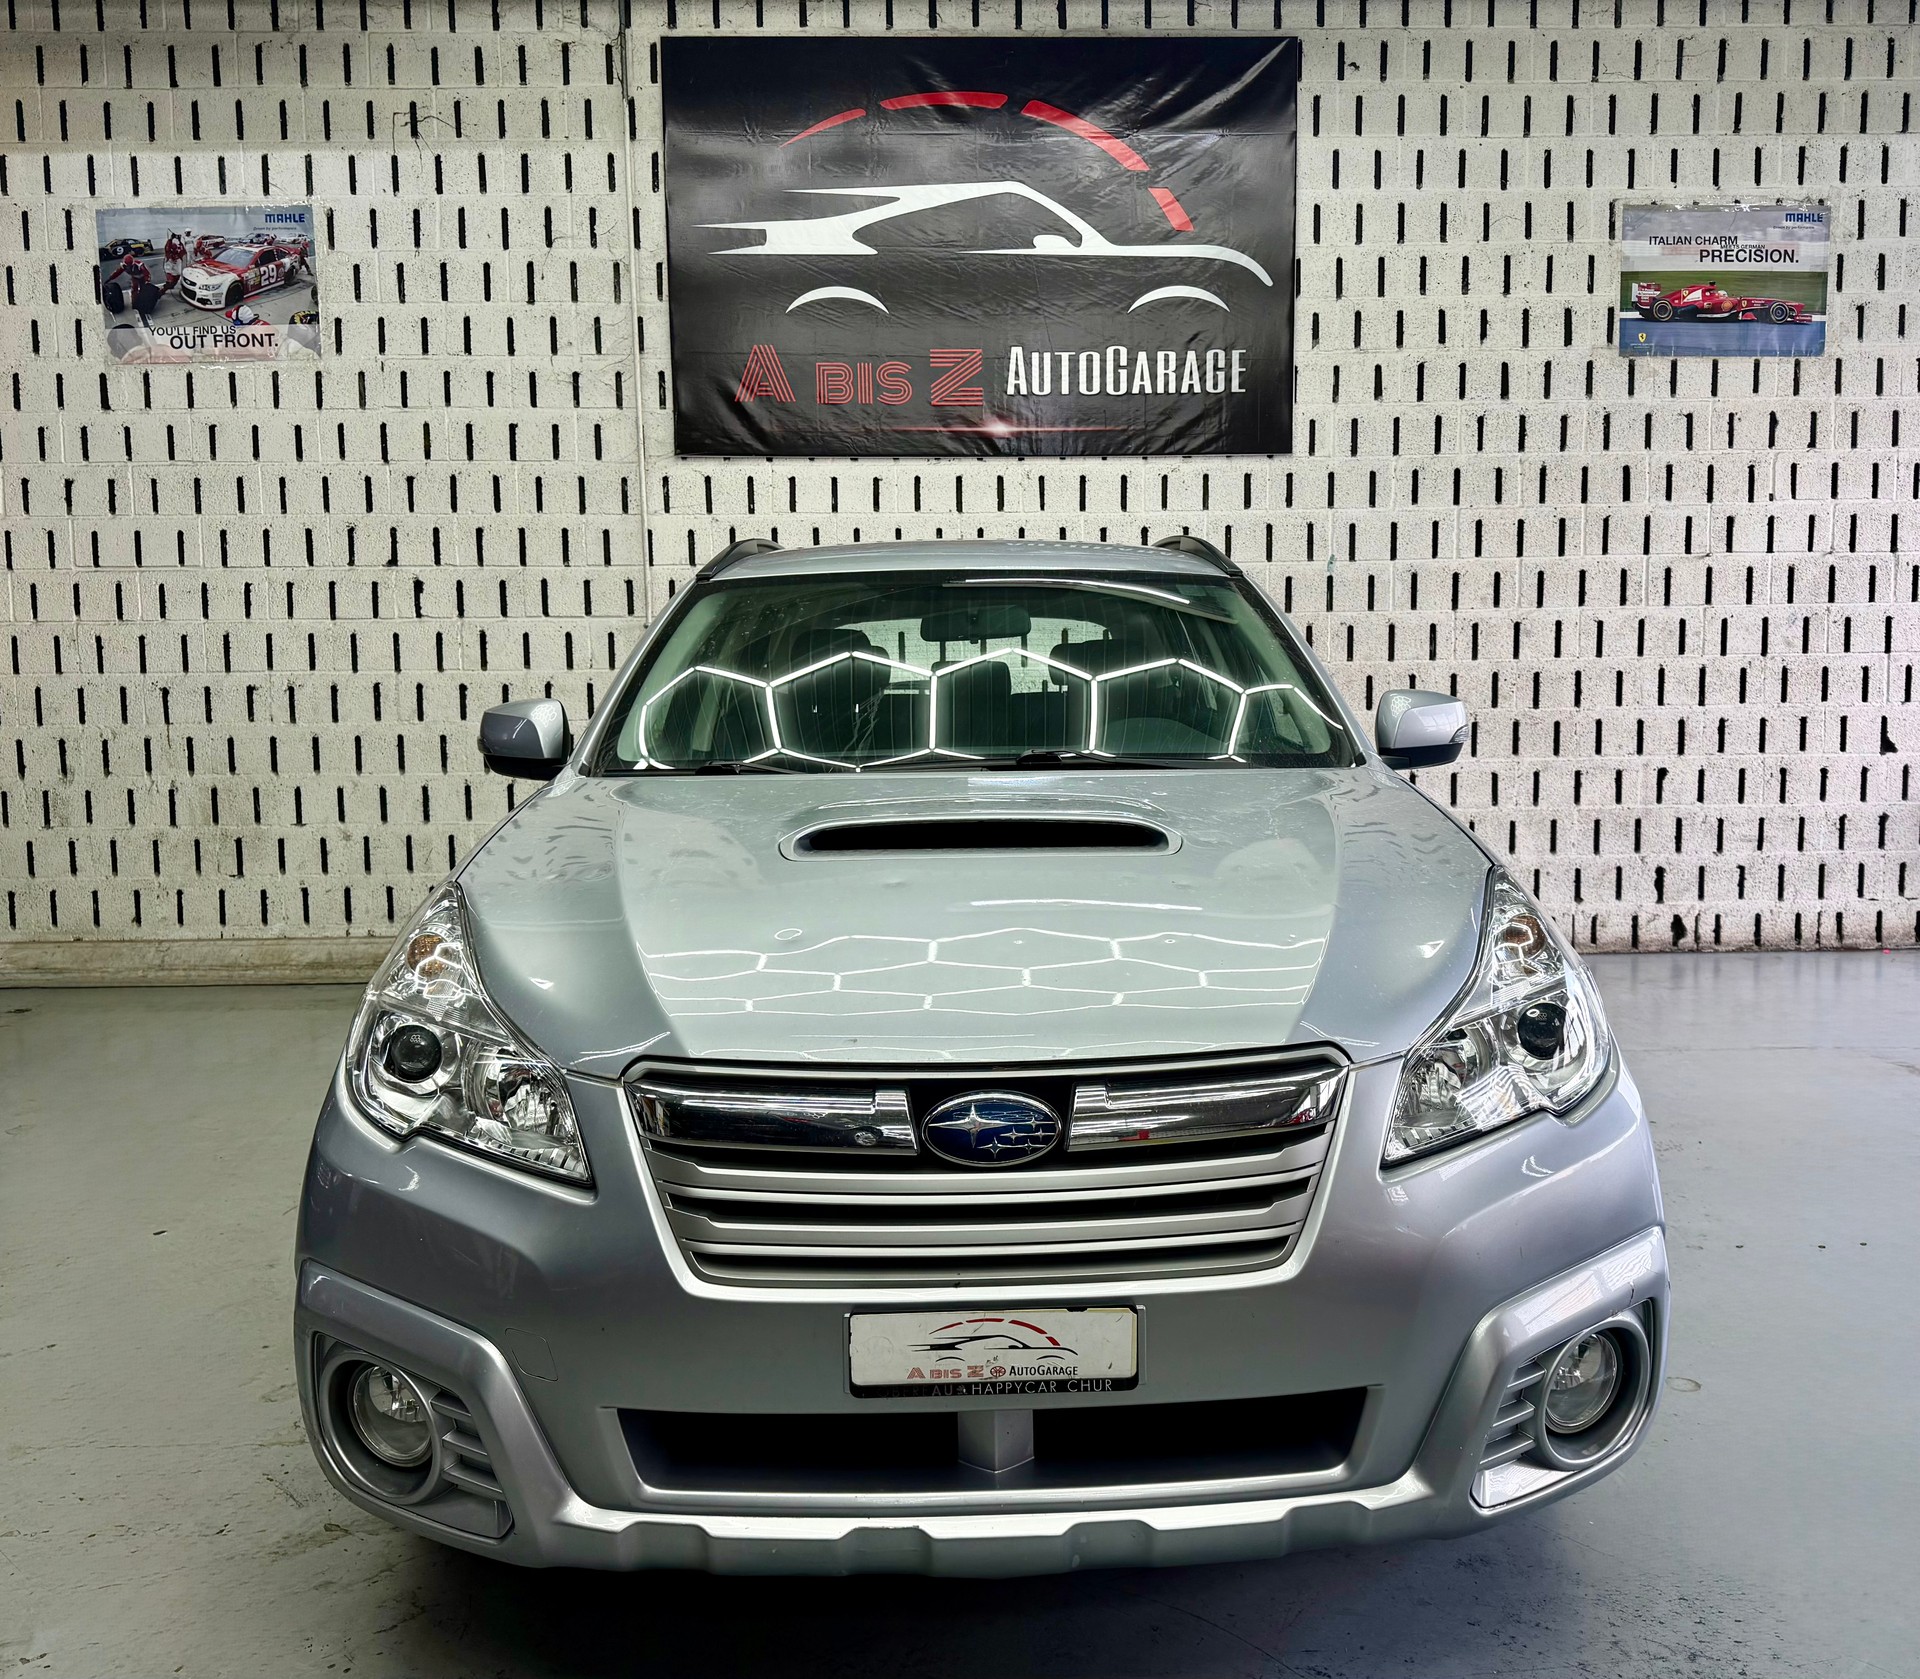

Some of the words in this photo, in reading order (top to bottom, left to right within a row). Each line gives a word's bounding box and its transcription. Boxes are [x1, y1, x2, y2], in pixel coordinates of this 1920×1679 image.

[265, 213, 306, 223] MAHLE
[1785, 213, 1824, 223] MAHLE
[1649, 236, 1692, 246] ITALIAN
[1695, 236, 1738, 246] CHARM
[1699, 249, 1799, 264] PRECISION.
[260, 264, 277, 287] 29
[149, 326, 191, 337] YOU'LL
[193, 326, 218, 335] FIND
[221, 325, 236, 335] US
[170, 334, 207, 350] OUT
[213, 333, 279, 348] FRONT.
[734, 343, 797, 403] A
[929, 348, 984, 407] Z
[906, 1367, 926, 1380] A
[967, 1365, 985, 1379] Z
[971, 1380, 1057, 1395] HAPPYCAR
[1067, 1379, 1112, 1393] CHUR
